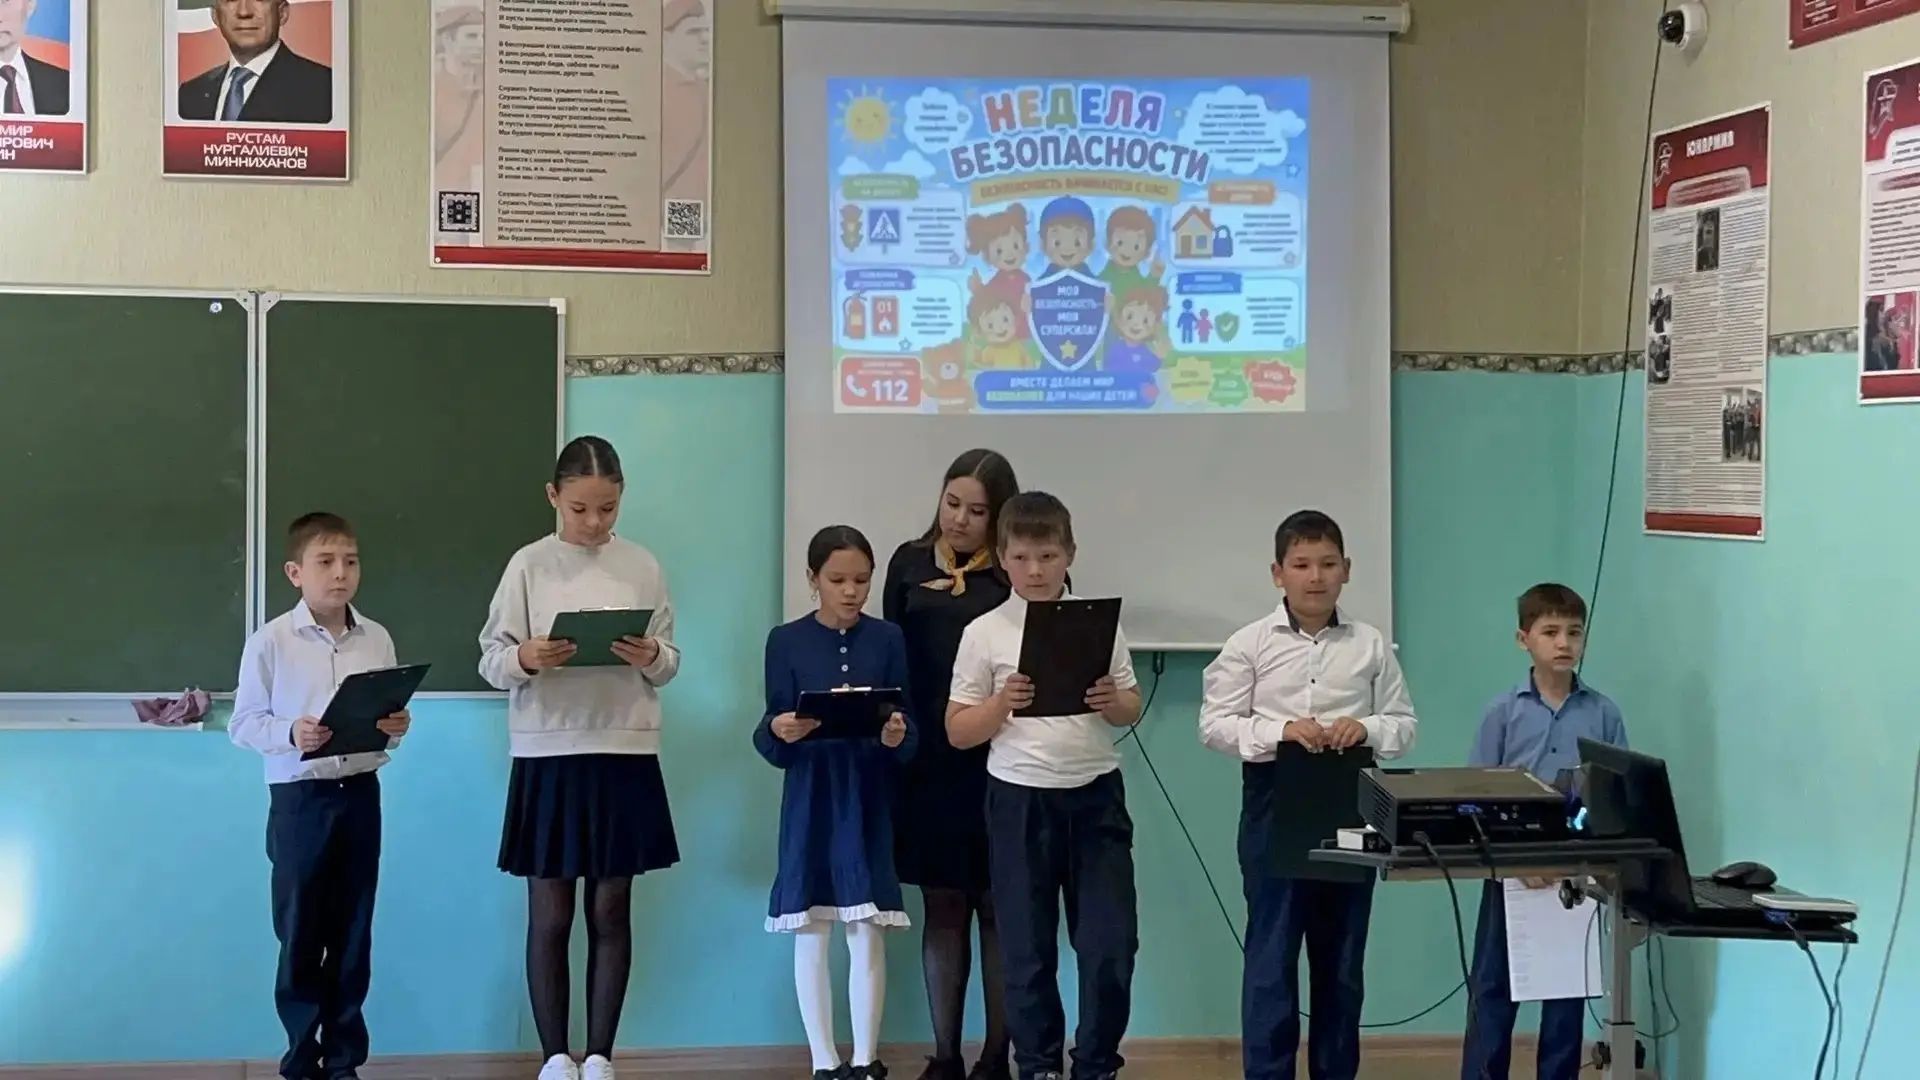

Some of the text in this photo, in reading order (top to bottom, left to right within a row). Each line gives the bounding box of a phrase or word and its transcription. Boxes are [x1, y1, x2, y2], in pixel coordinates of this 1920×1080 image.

[984, 88, 1162, 132] НЕДЕЛЯ
[226, 132, 285, 144] РУСТАМ
[203, 144, 308, 157] НУРГАЛИЕВИЧ
[204, 156, 307, 169] МИННИХАНОВ
[951, 134, 1210, 183] БЕЗОПАСНОСТИ
[877, 301, 892, 313] 01
[872, 379, 909, 402] 112
